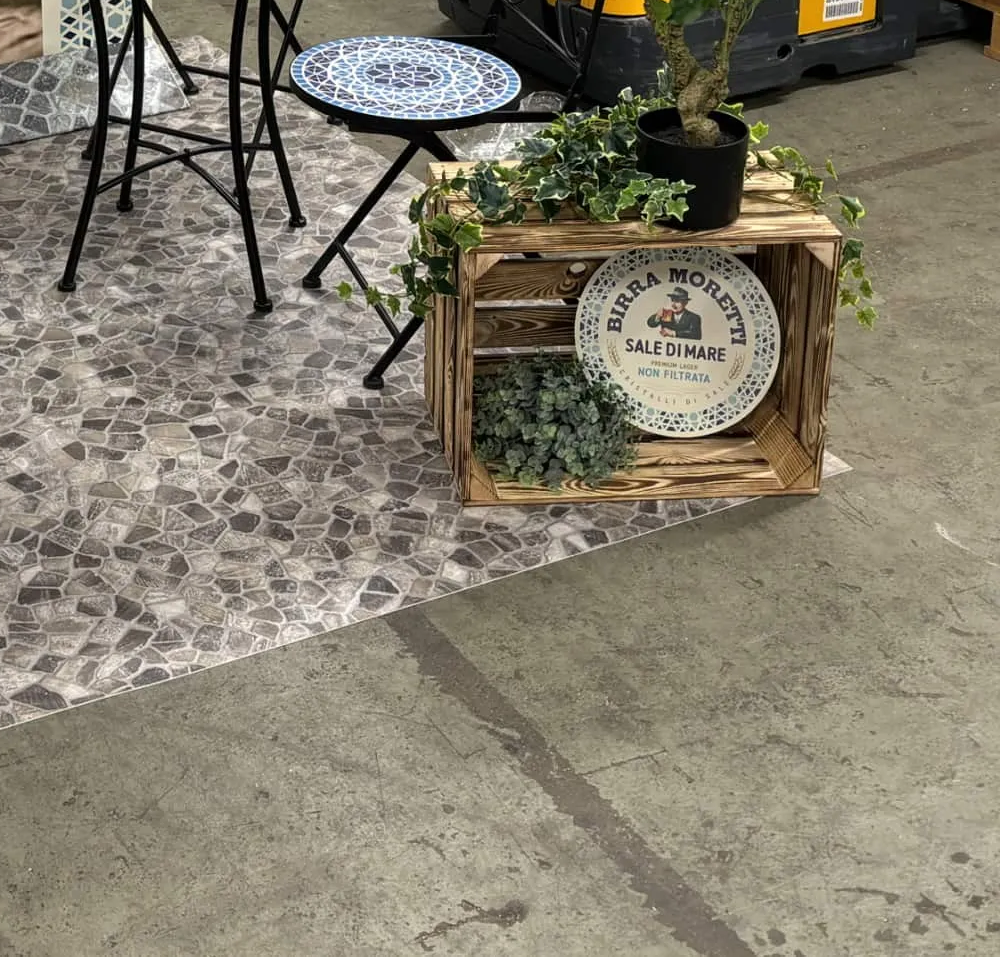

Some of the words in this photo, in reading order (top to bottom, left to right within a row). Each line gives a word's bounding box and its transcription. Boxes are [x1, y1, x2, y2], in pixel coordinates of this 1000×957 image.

[607, 272, 662, 333] BIRRA
[668, 268, 747, 346] MORETTI
[625, 338, 662, 355] SALE
[666, 343, 681, 357] DI
[684, 344, 727, 362] MARE
[638, 367, 660, 378] NON
[664, 370, 711, 383] FILTRATA
